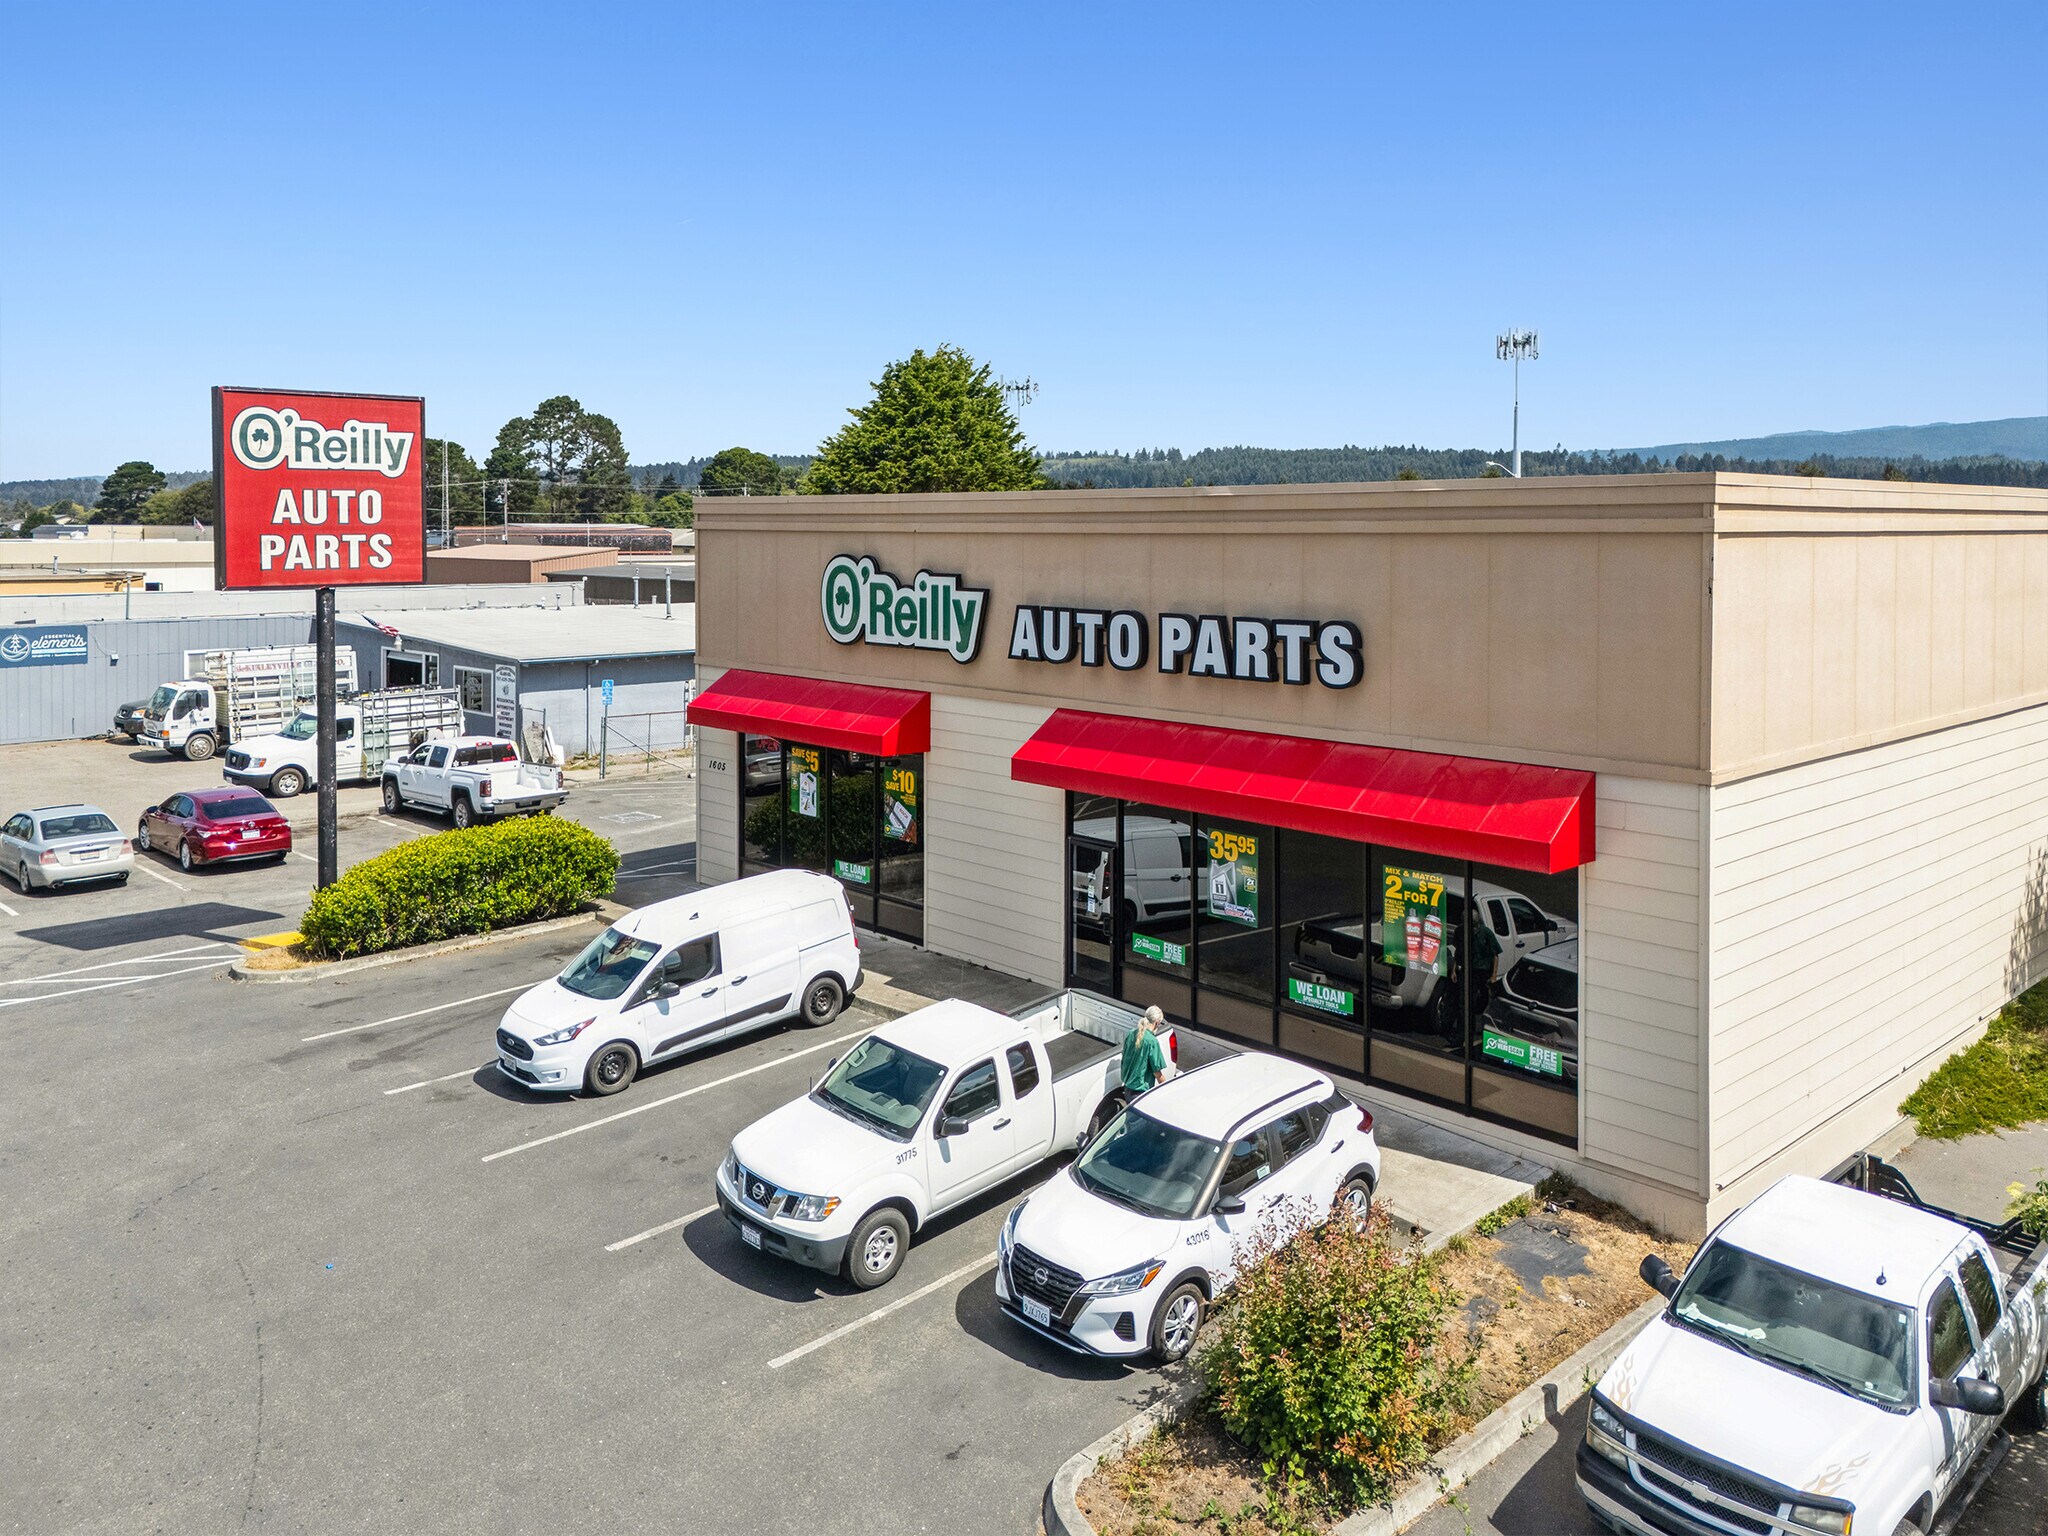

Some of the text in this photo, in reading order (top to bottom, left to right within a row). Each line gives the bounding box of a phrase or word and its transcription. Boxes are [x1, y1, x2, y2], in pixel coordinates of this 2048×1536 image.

[238, 412, 406, 472] O'Reilly
[271, 489, 383, 525] AUTO
[259, 533, 393, 571] PARTS
[824, 563, 977, 654] O'Reilly
[32, 635, 87, 648] elements
[1008, 605, 1363, 689] AUTO PARTS
[709, 759, 726, 771] 1605
[791, 747, 806, 758] SAVE
[805, 750, 819, 772] $5
[885, 780, 900, 791] SAVE
[892, 769, 915, 794] $10
[839, 860, 867, 877] WE LOAN
[1385, 867, 1443, 884] MIX & MATCH
[1385, 875, 1444, 907] 2 FOR $7
[1163, 942, 1182, 955] FREE
[1296, 980, 1346, 1005] WE LOAN
[1529, 1045, 1557, 1063] FREE
[896, 1147, 917, 1165] 31775
[1186, 1229, 1210, 1246] 43016
